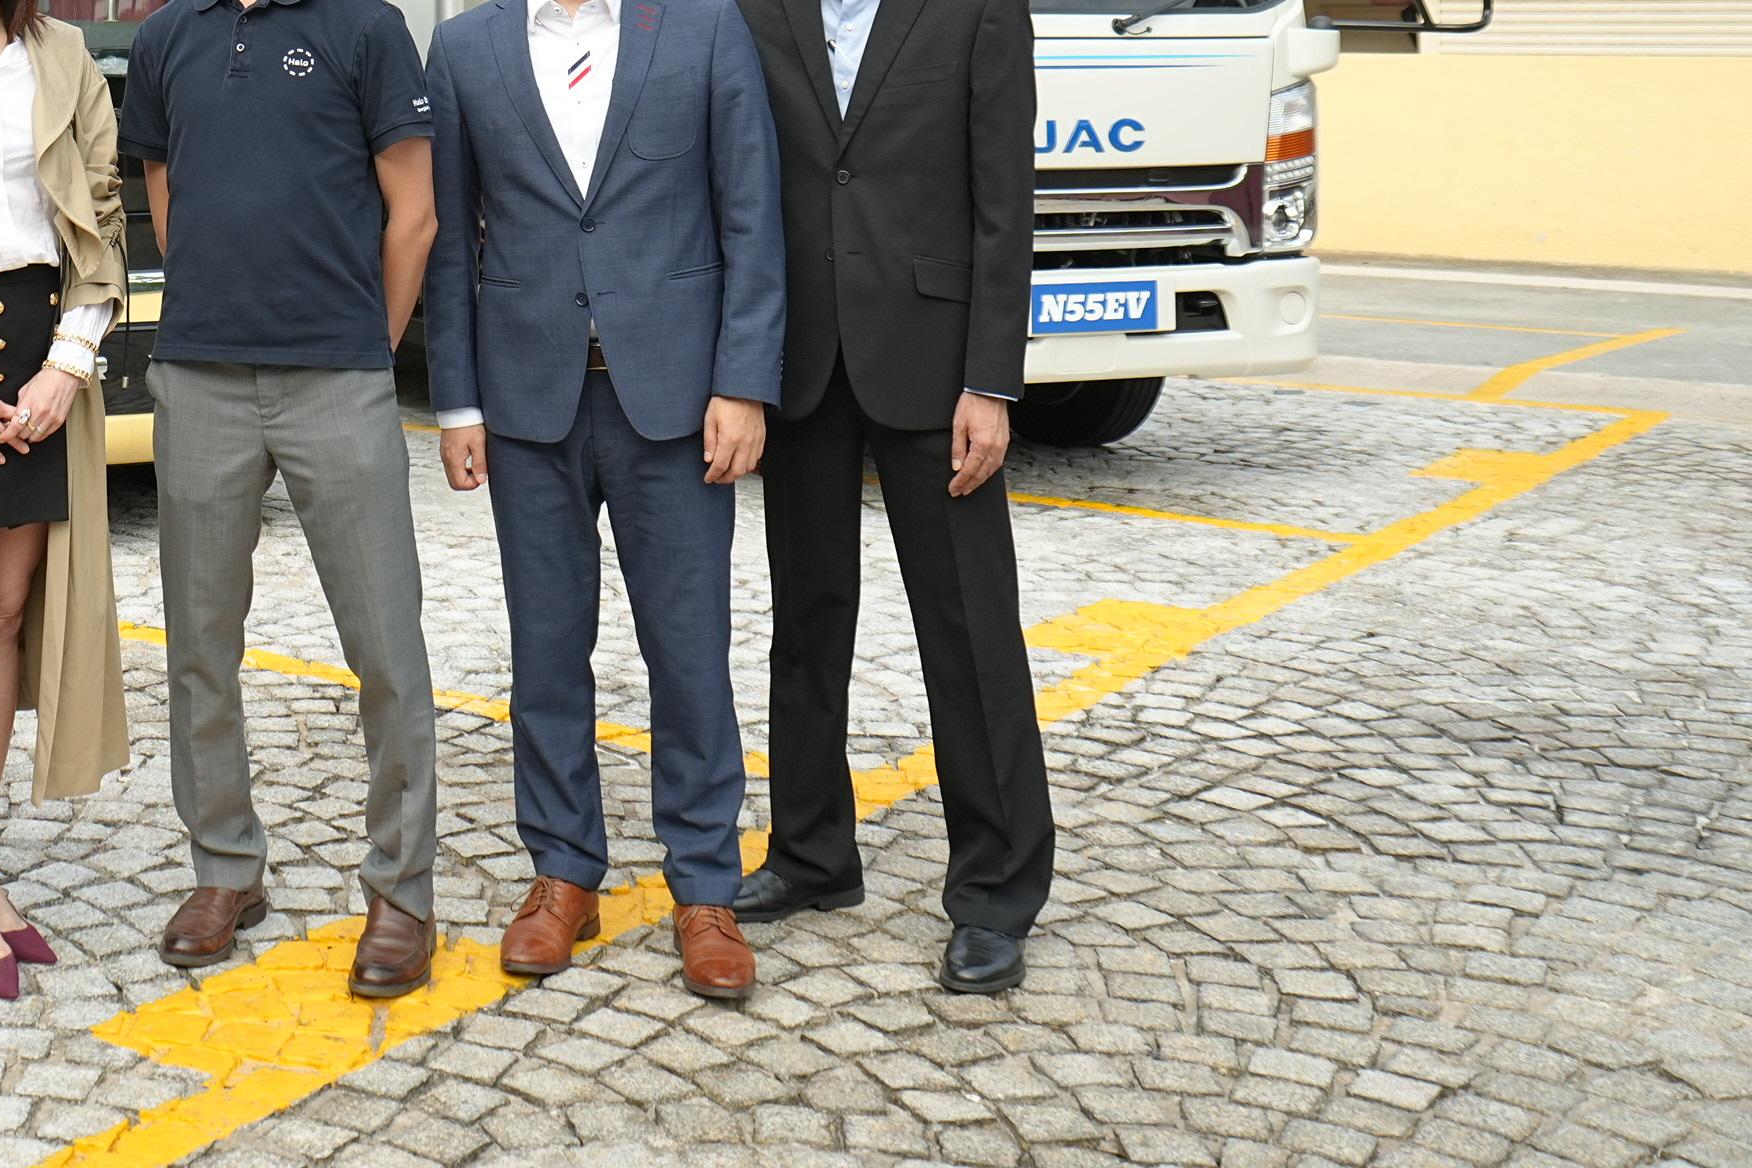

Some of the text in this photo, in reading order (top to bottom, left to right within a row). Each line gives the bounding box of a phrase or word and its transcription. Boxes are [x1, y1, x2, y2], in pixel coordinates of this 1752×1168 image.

[288, 57, 309, 67] Halo
[1034, 118, 1146, 154] JAC
[1038, 290, 1151, 323] N55EV
